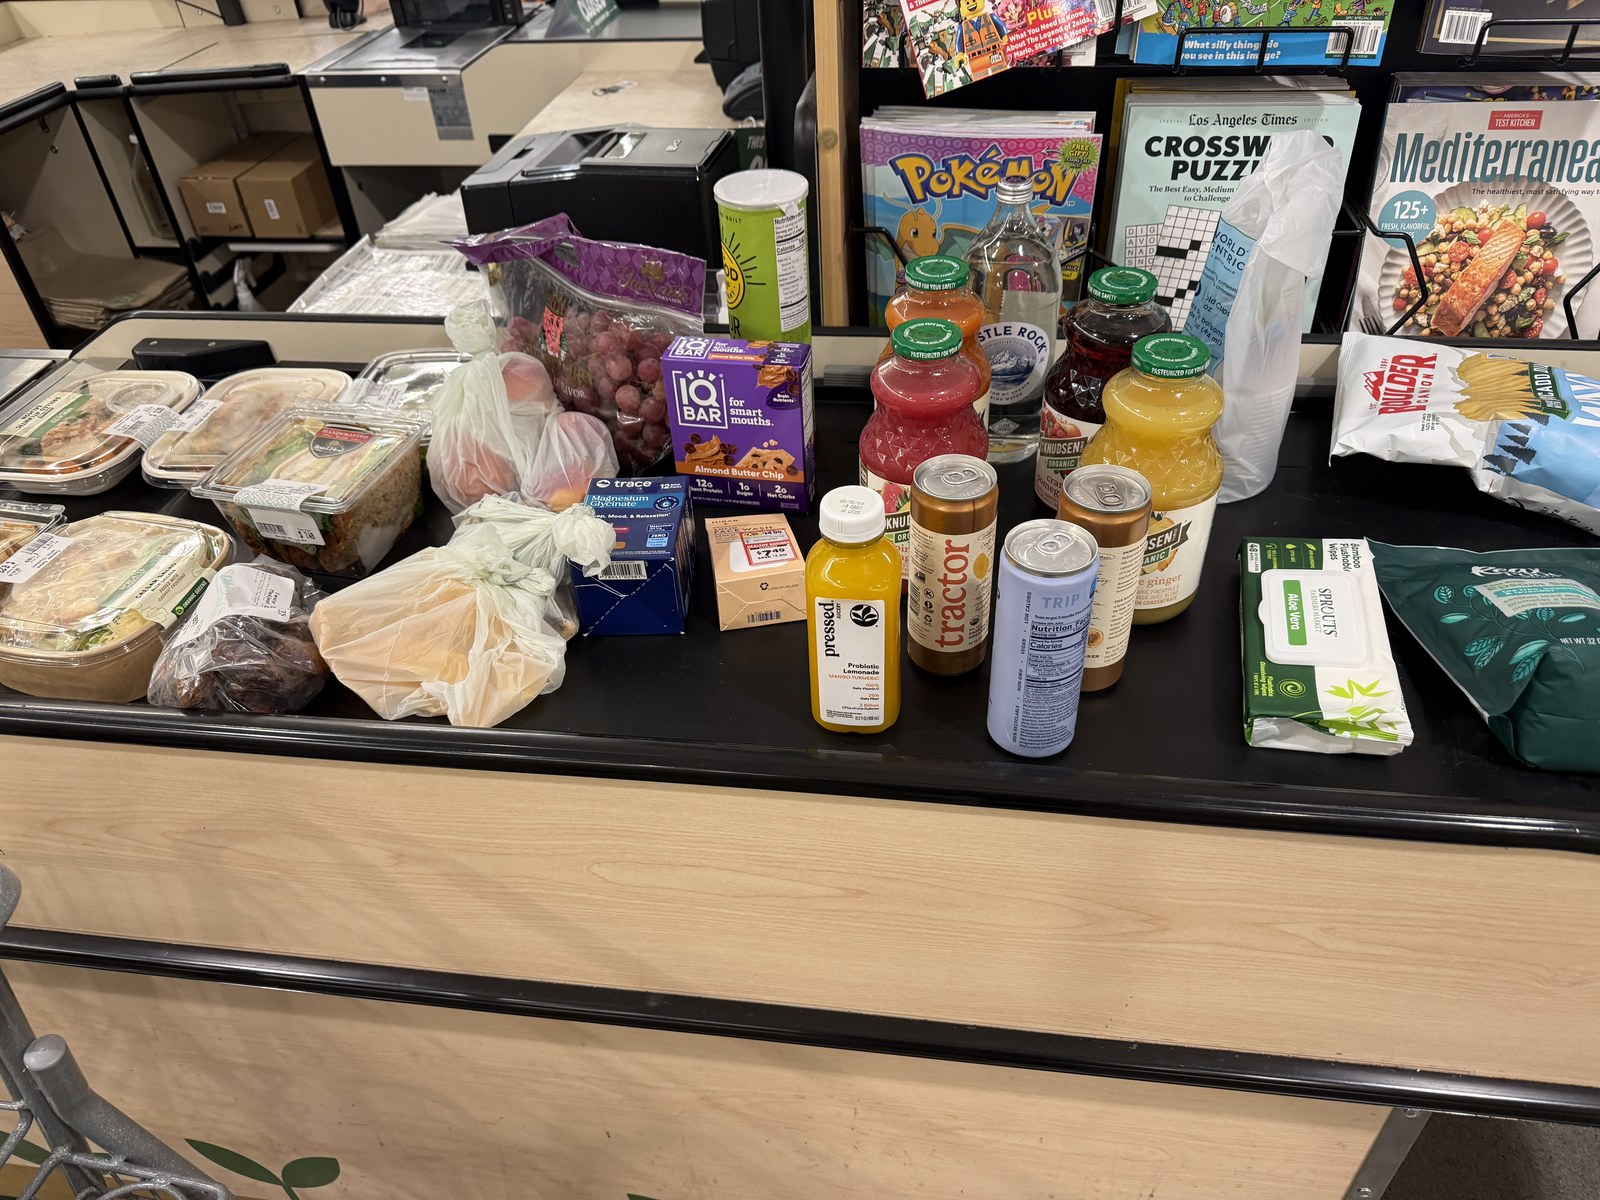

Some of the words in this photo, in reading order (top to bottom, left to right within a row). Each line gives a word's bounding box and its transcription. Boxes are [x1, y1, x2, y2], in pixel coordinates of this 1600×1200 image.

[1027, 5, 1060, 25] Plus
[1009, 31, 1027, 42] What
[1028, 26, 1040, 35] You
[1041, 21, 1057, 30] Need
[1066, 10, 1085, 20] Know
[1006, 43, 1026, 52] About
[1027, 37, 1039, 46] The
[1040, 27, 1064, 41] Legend
[1034, 42, 1048, 50] Star
[1049, 36, 1063, 46] Trek
[1070, 26, 1088, 38] More!
[1184, 40, 1210, 50] What
[1211, 40, 1232, 51] silly
[1266, 40, 1279, 49] do
[1215, 51, 1225, 59] in
[1226, 50, 1247, 59] this
[1249, 51, 1281, 61] imge?
[1189, 113, 1209, 126] Los
[1211, 113, 1257, 128] Angeles
[1261, 113, 1297, 126] Times
[1495, 118, 1509, 127] TEST
[1510, 118, 1535, 127] KITCHEN
[1149, 185, 1164, 193] The
[1165, 185, 1181, 193] Best
[1182, 185, 1202, 195] Easy,
[1203, 185, 1235, 193] Medium
[1472, 188, 1485, 196] The
[1487, 187, 1524, 197] healthiest,
[1526, 188, 1544, 196] most
[1545, 188, 1580, 197] satisfying
[1581, 189, 1595, 197] way
[1193, 194, 1231, 203] Challenge
[1394, 201, 1429, 219] 125+
[1400, 222, 1430, 230] FLAVORFUL
[942, 282, 956, 290] SAFETY
[678, 340, 706, 351] IQ
[978, 326, 1012, 342] STLE
[1017, 327, 1047, 353] ROCK
[1151, 367, 1184, 376] PASTEURIZED
[1185, 367, 1194, 376] FOR
[679, 377, 720, 407] IQ
[729, 397, 745, 407] for
[684, 406, 722, 423] BAR
[730, 408, 763, 417] smart
[731, 417, 774, 427] mouths.
[1044, 441, 1080, 454] KNUDSEN
[1049, 459, 1075, 467] ORGANIC
[695, 465, 729, 475] Almond
[732, 468, 760, 477] Butter
[762, 470, 784, 480] Chip
[591, 495, 648, 503] Magnesium
[1328, 543, 1338, 561] Wipes
[1350, 543, 1361, 569] Bamboo
[1147, 574, 1182, 588] ginger
[182, 592, 197, 609] ORGANIC
[195, 581, 208, 596] GREENS
[935, 539, 970, 648] tractor
[1310, 589, 1319, 611] FARMERS
[1042, 594, 1080, 608] TRIP
[1287, 593, 1298, 611] Aloe
[1318, 588, 1338, 636] SPROUTS
[1031, 623, 1072, 632] Nutrition
[1289, 611, 1300, 630] Vera
[1312, 611, 1322, 633] MARKET
